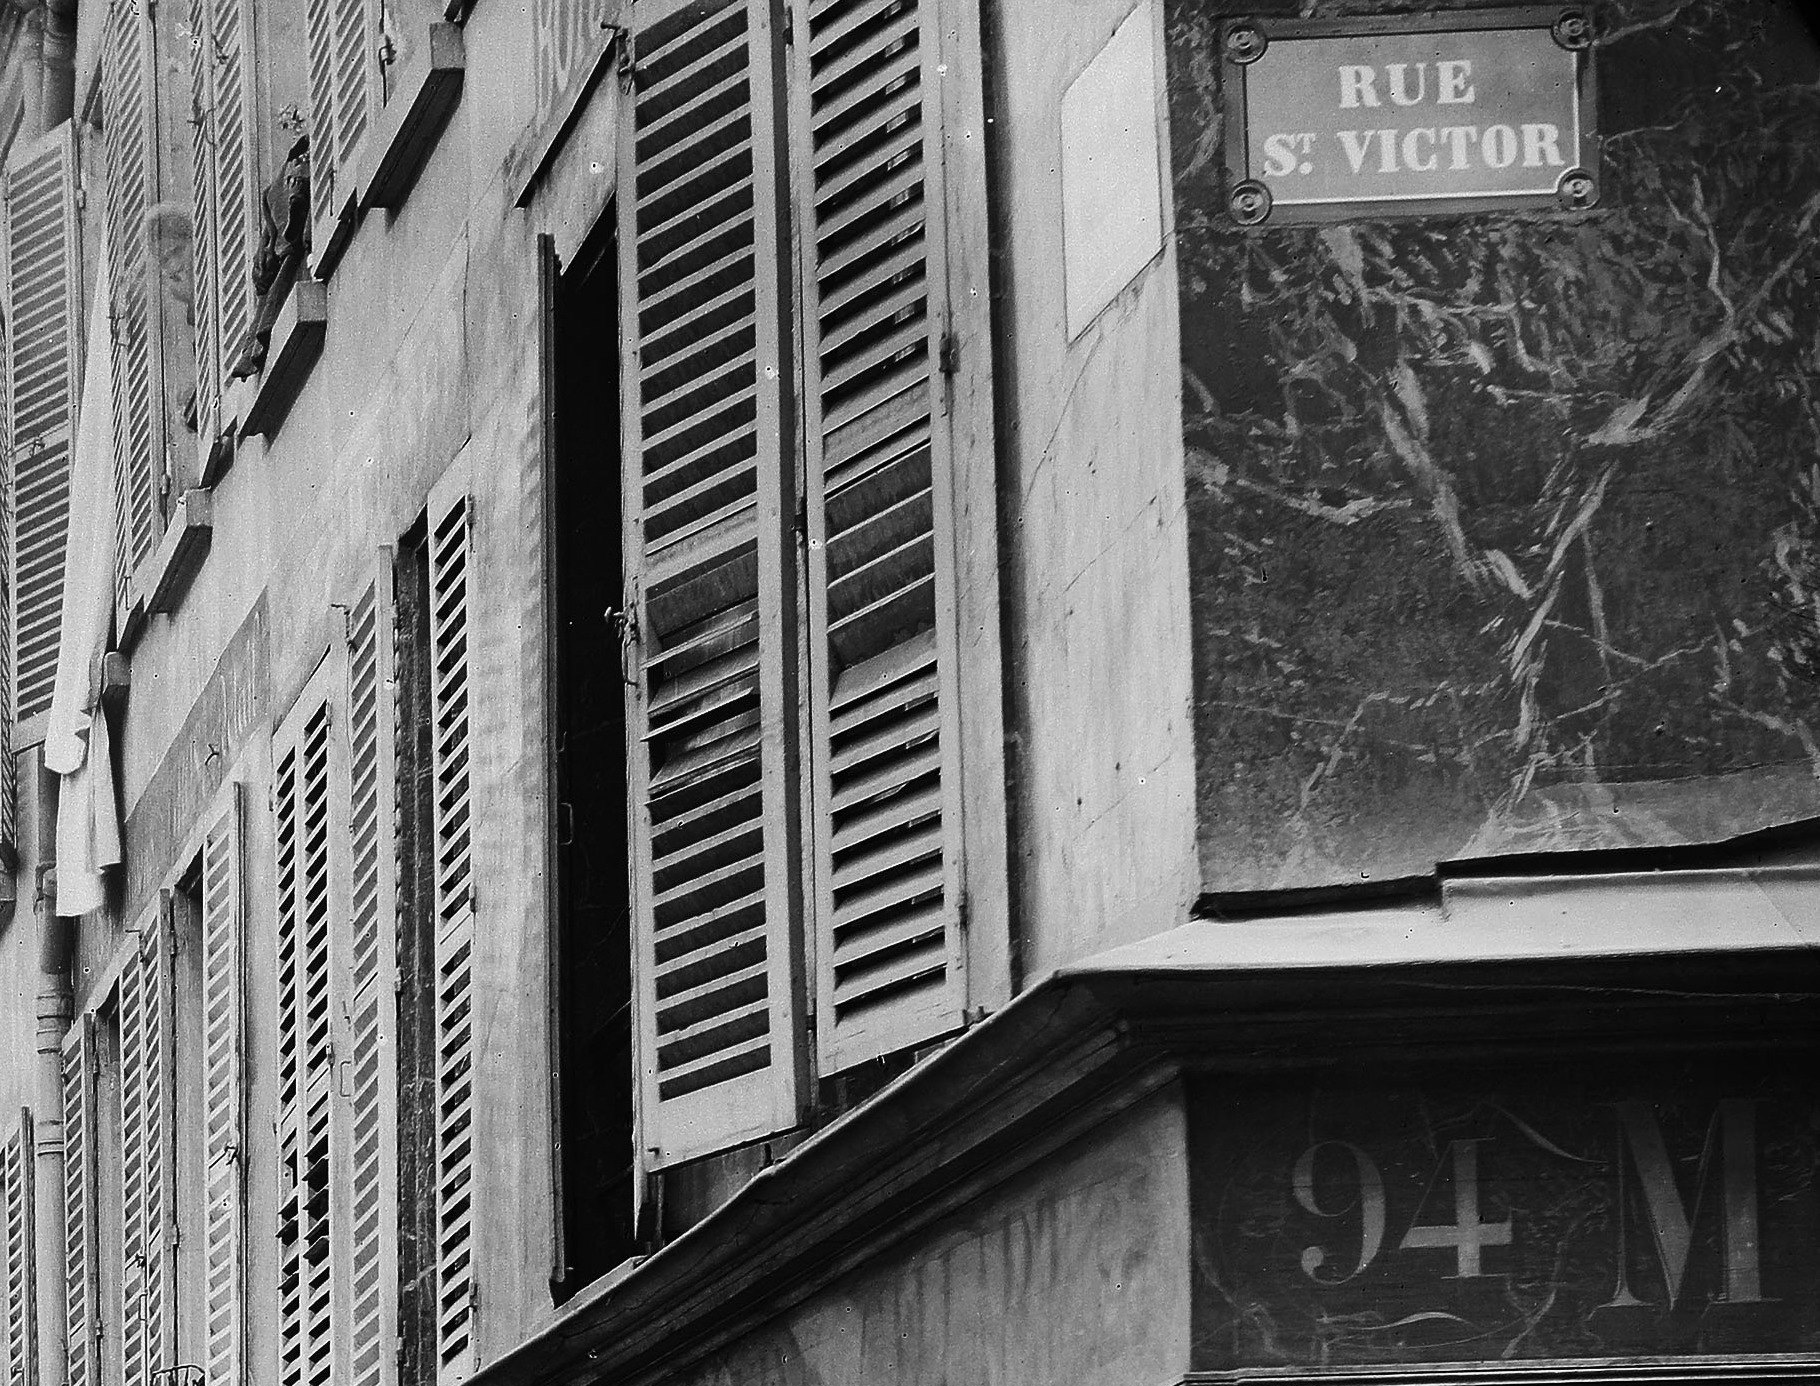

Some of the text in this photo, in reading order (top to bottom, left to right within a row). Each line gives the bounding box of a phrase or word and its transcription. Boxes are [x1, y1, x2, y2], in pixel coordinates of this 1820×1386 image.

[1337, 59, 1476, 109] RUE
[1336, 122, 1566, 174] VICTOR
[1290, 1138, 1514, 1285] 94
